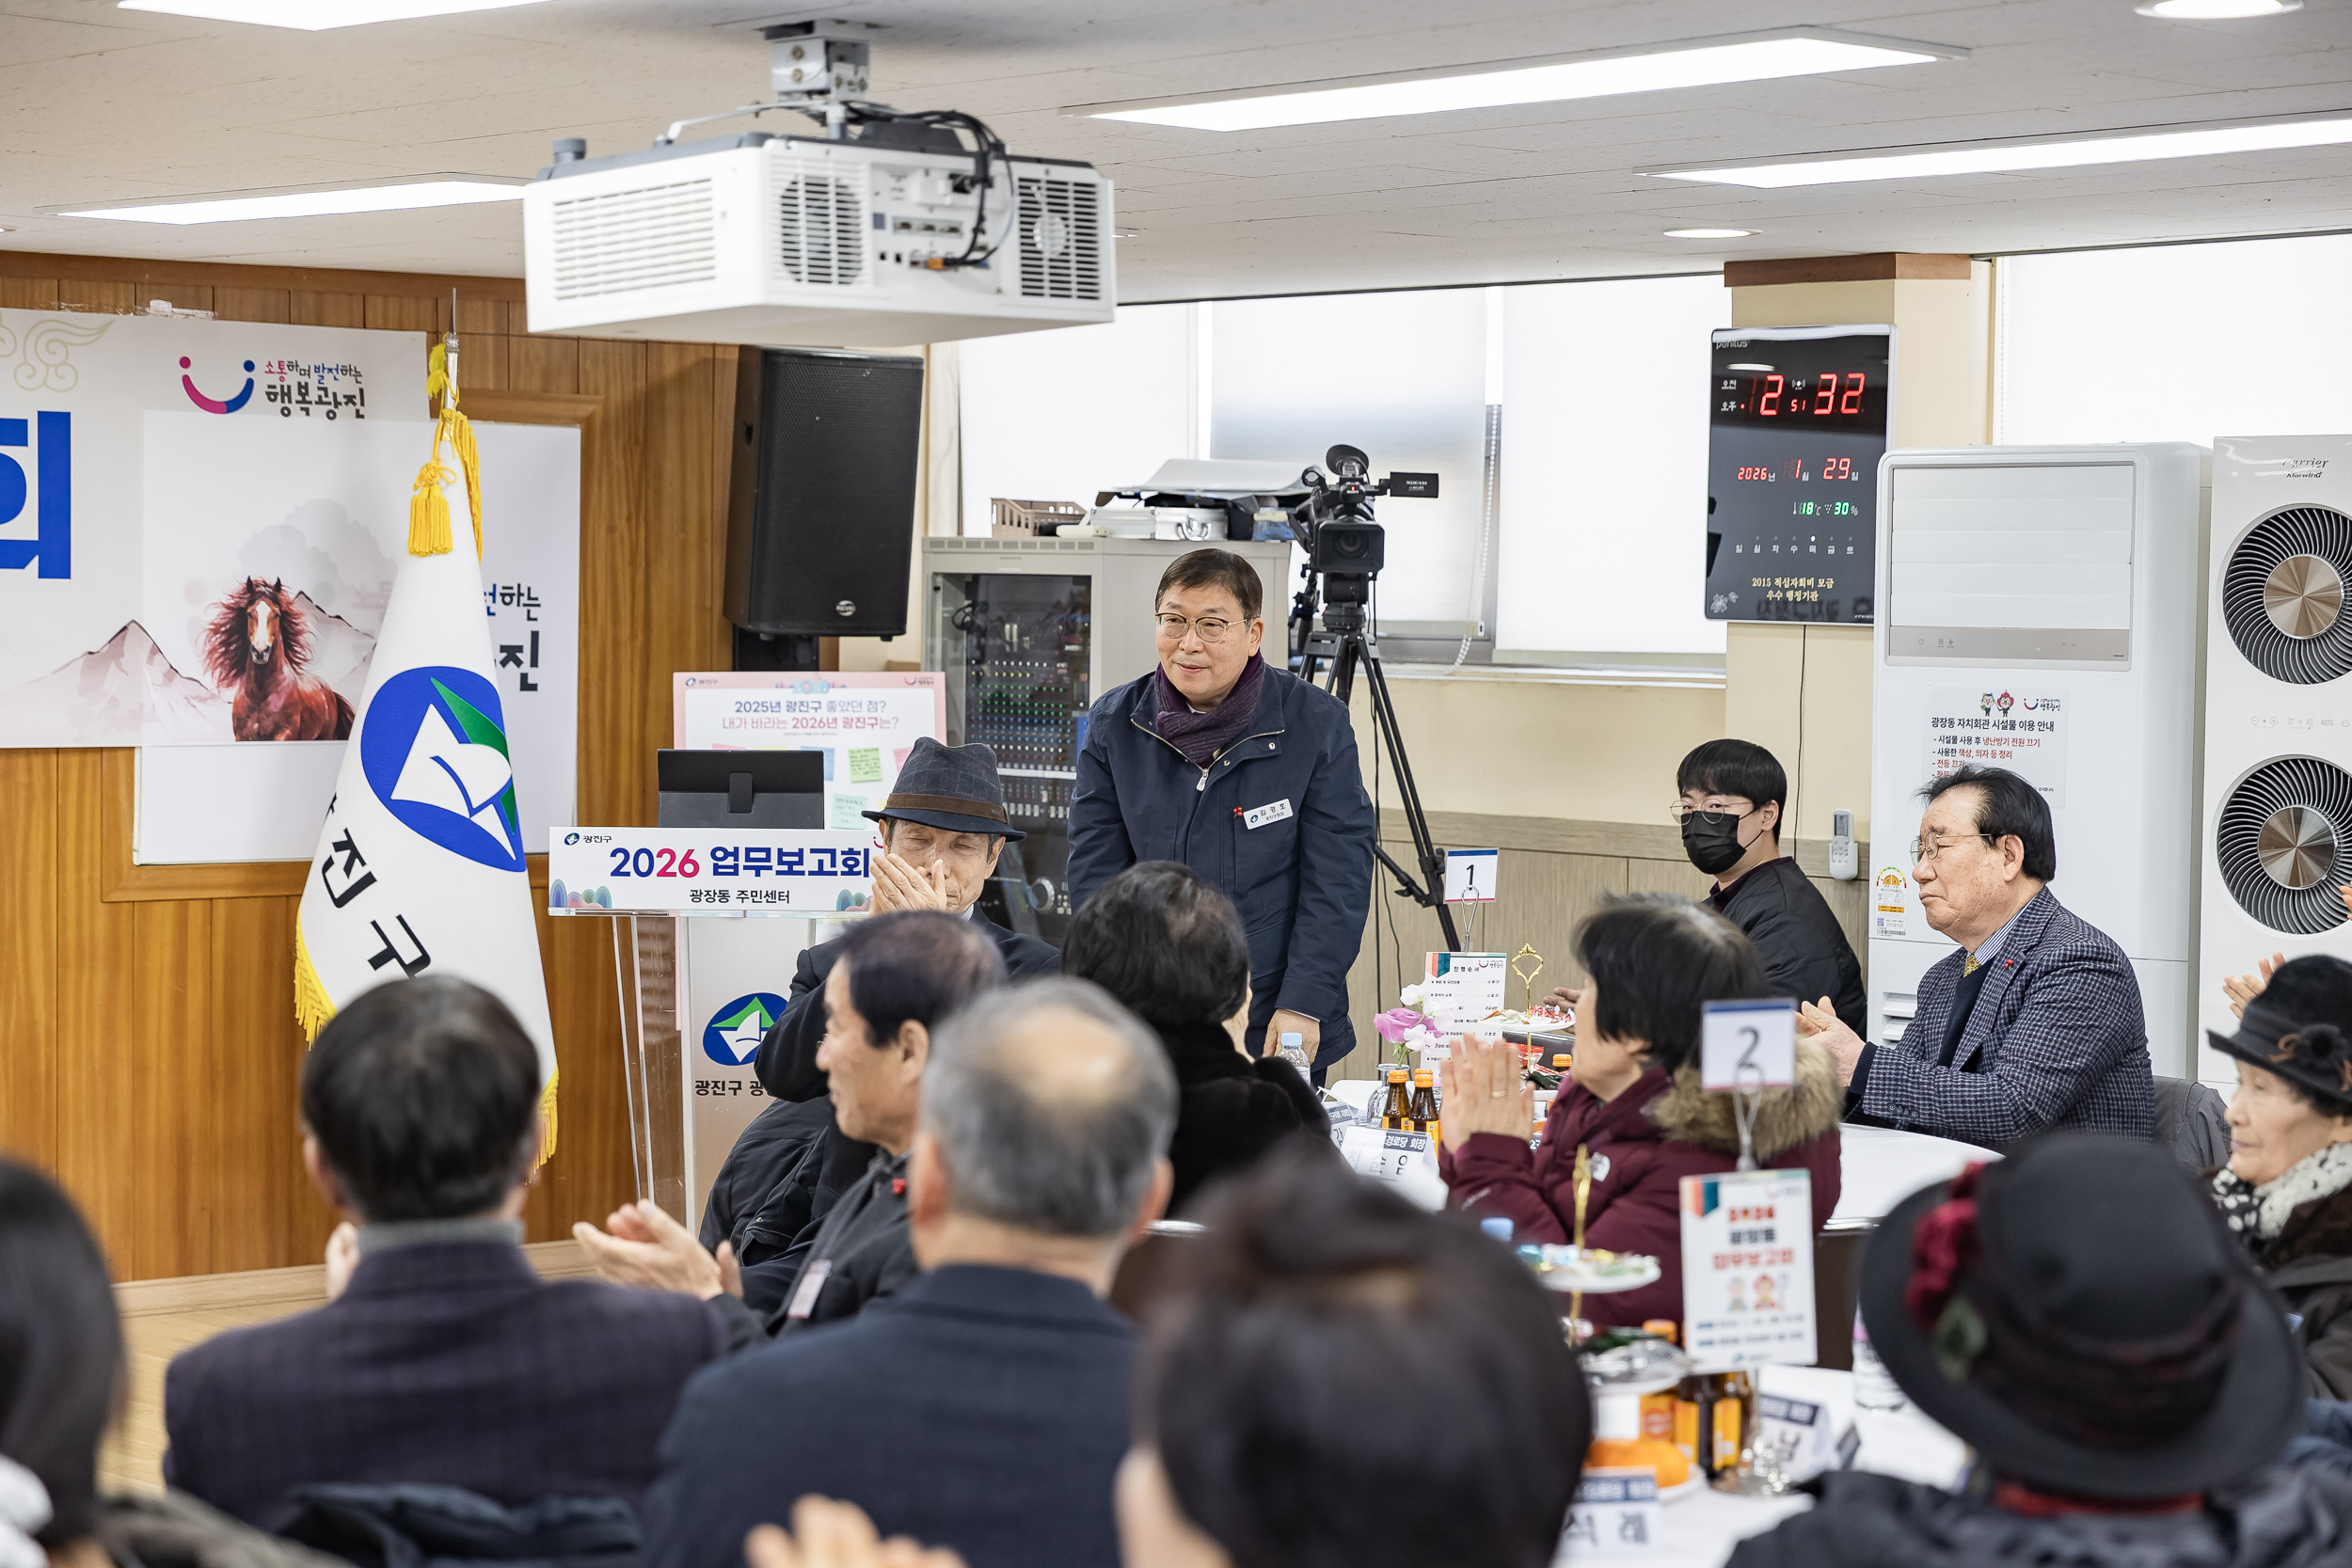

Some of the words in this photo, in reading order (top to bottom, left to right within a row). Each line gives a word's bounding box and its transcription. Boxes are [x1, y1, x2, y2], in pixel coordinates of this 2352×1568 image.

[264, 359, 311, 383] 소통하며
[313, 362, 363, 385] 발전하는
[264, 380, 365, 420] 행복광진
[1752, 578, 1772, 588] 2015
[1773, 577, 1815, 589] 적십자회비
[1817, 578, 1835, 590] 모금
[1766, 590, 1784, 601] 우수
[1786, 590, 1820, 602] 행정기관
[735, 700, 781, 713] 2025년
[785, 700, 822, 713] 광진구
[826, 700, 863, 713] 좋았던
[866, 700, 887, 713] 점?
[722, 717, 748, 730] 내가
[751, 717, 788, 730] 바라는
[791, 717, 838, 730] 2026년
[842, 717, 899, 730] 광진구는?
[1931, 717, 1956, 729] 광장동
[1957, 718, 1991, 730] 자치회관
[1992, 719, 2017, 731] 시설물
[2018, 720, 2035, 732] 이용
[2037, 721, 2055, 732] 안내
[2320, 719, 2334, 727] AUTO
[1938, 736, 1958, 745] 시설물
[1959, 736, 1973, 746] 사용
[1974, 736, 1981, 745] 후
[1982, 736, 2010, 747] 냉난방기
[2010, 737, 2026, 748] 전원
[2026, 738, 2041, 748] 끄기
[1936, 748, 1957, 757] 사용한
[1975, 749, 1989, 758] 의자
[1990, 750, 1998, 759] 등
[1998, 750, 2012, 759] 정리
[1936, 759, 1950, 768] 전등
[582, 835, 612, 844] 광진구
[610, 847, 700, 879] 2026
[709, 846, 870, 879] 업무보고회
[1466, 863, 1475, 891] 1
[323, 792, 432, 979] 진구
[689, 889, 731, 904] 광장동
[735, 889, 790, 904] 주민센터
[1737, 1025, 1761, 1069] 2
[694, 1080, 742, 1097] 광진구
[1409, 1137, 1426, 1150] 회장
